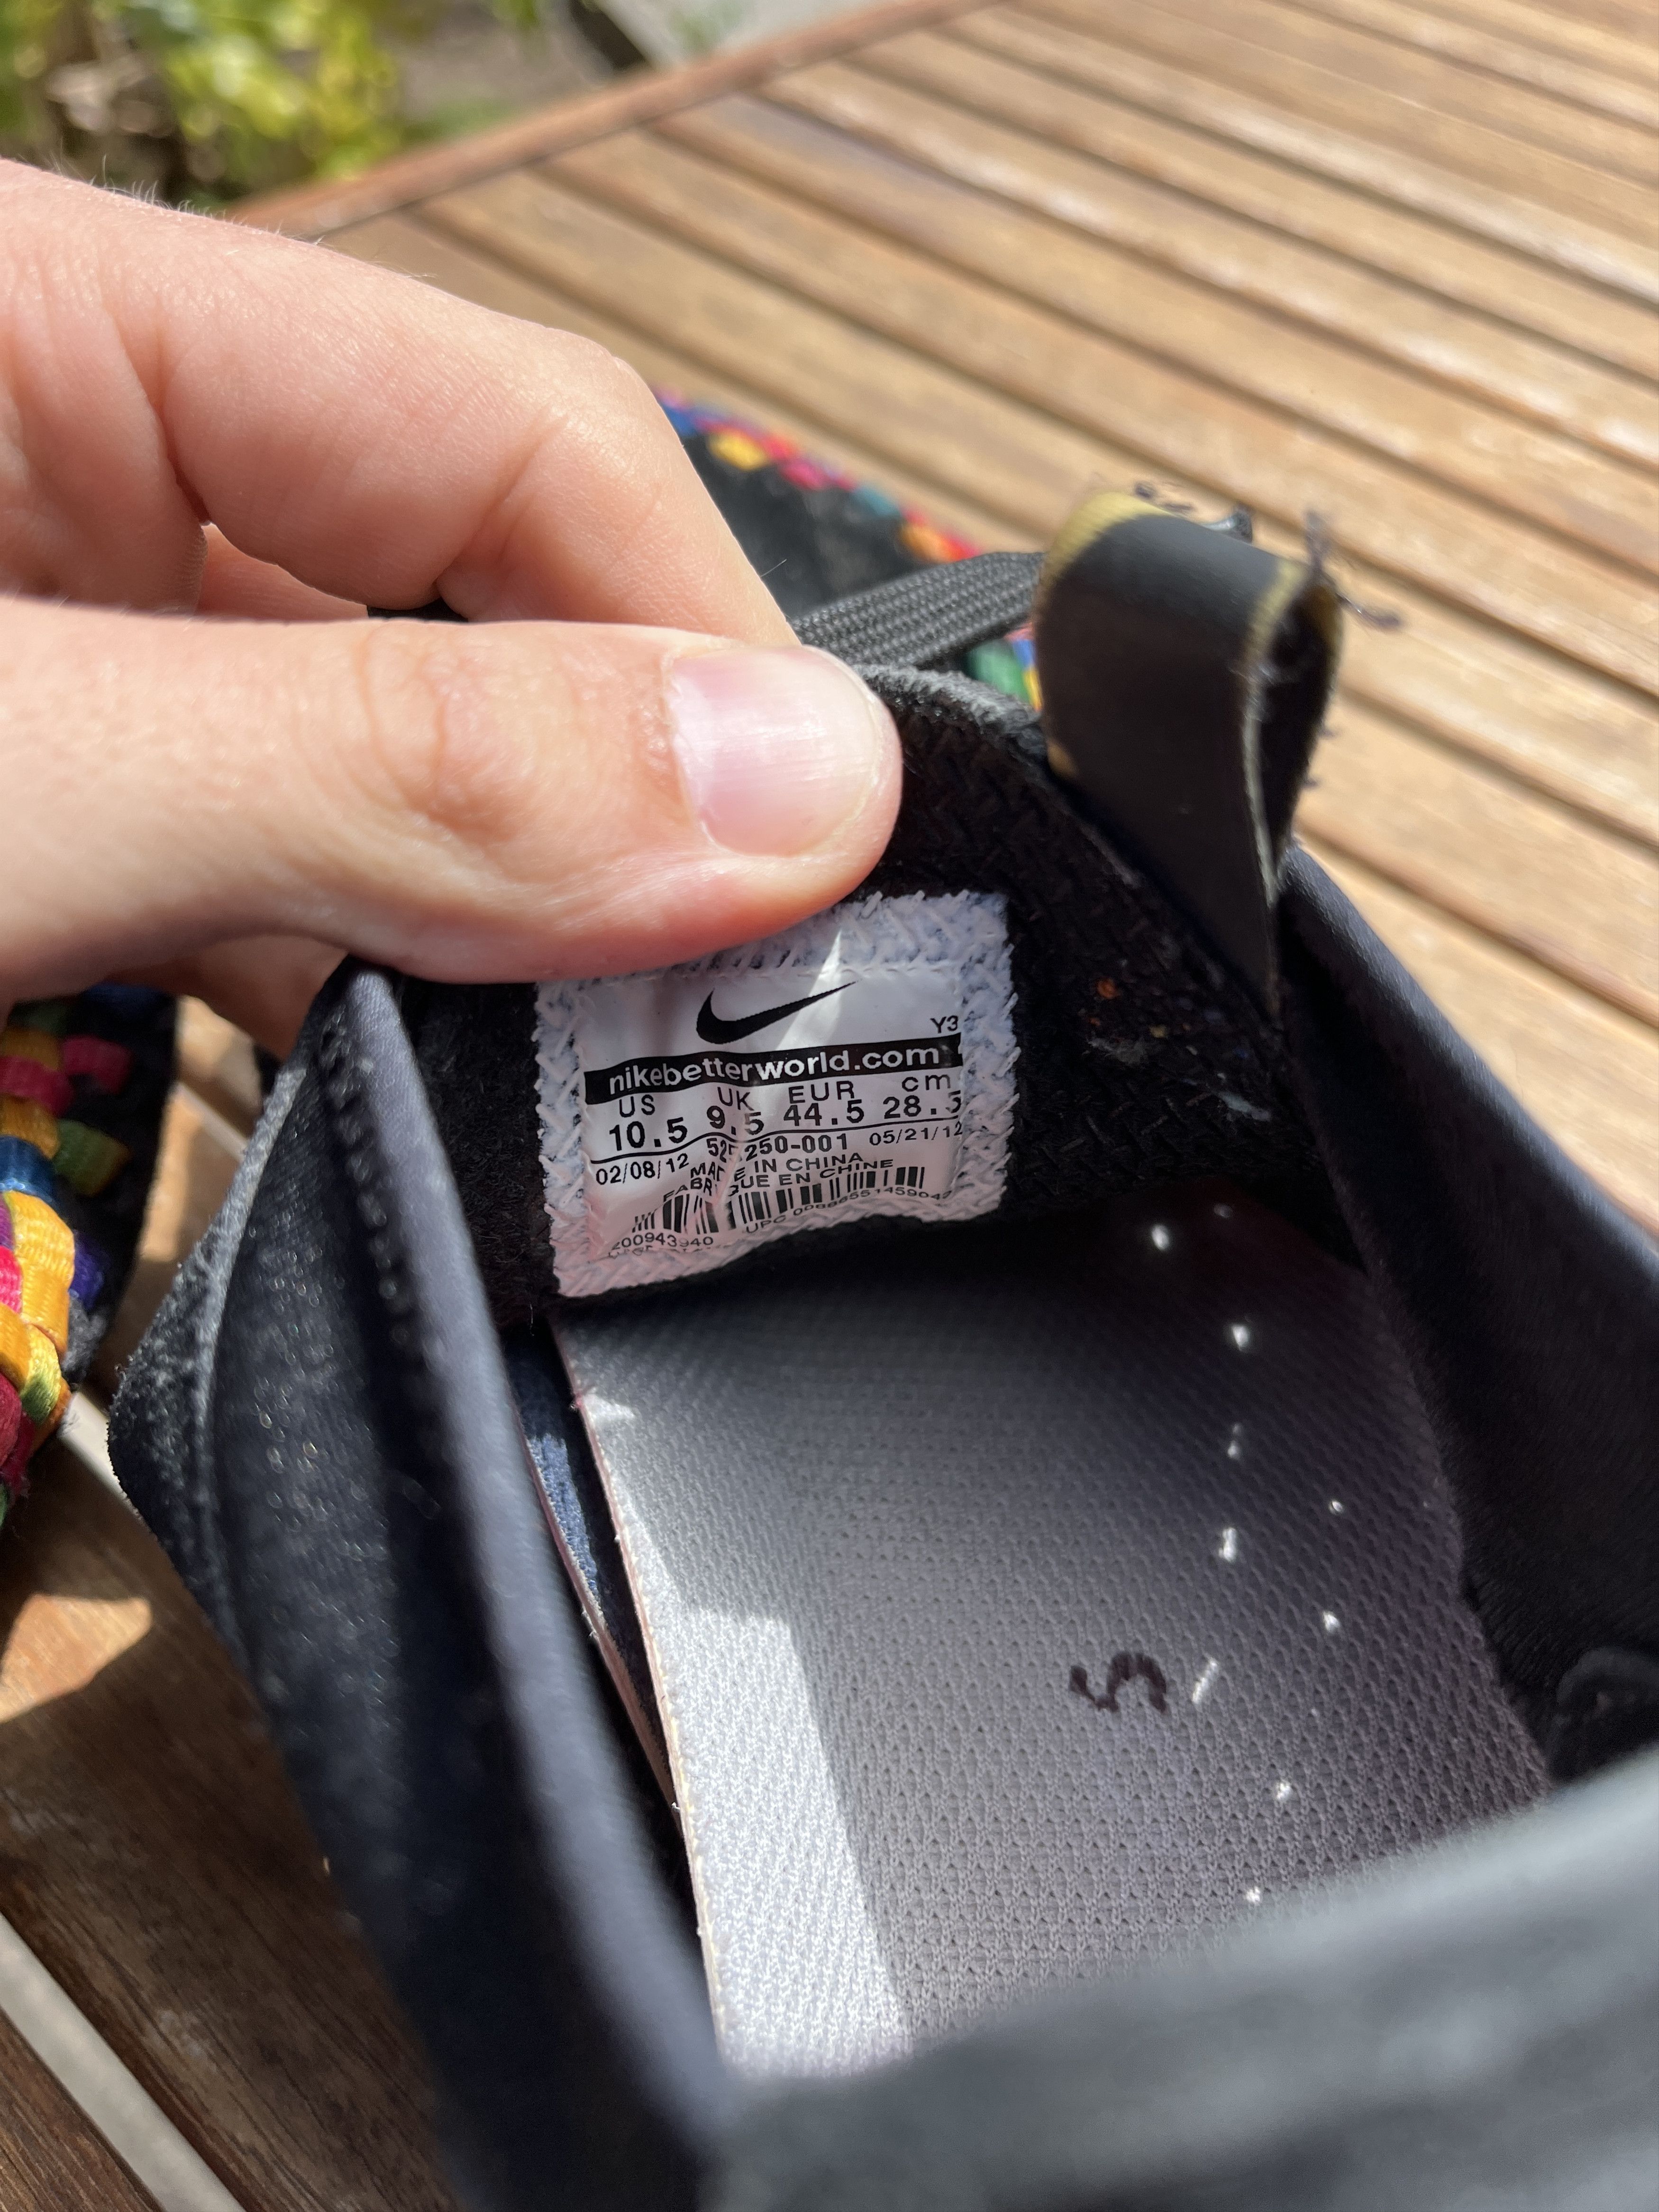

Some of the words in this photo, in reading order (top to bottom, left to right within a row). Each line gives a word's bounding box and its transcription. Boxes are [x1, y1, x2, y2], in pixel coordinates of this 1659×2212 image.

[930, 1015, 959, 1034] Y3
[610, 1047, 939, 1095] nikebetterworld.com
[619, 1094, 655, 1118] US
[717, 1086, 755, 1111] UK
[788, 1080, 855, 1104] EUR
[902, 1074, 951, 1092] cm
[609, 1117, 688, 1151] 10.5
[706, 1105, 765, 1136] 9.5
[784, 1099, 865, 1127] 44.5
[883, 1090, 962, 1120] 28.5
[596, 1153, 689, 1185] 02/08/12
[869, 1121, 963, 1146] 05/21/12
[755, 1158, 777, 1173] IN
[786, 1152, 864, 1172] CHINA
[663, 1174, 770, 1202] FABRQUE
[779, 1173, 811, 1186] EN
[820, 1159, 893, 1178] CHINE
